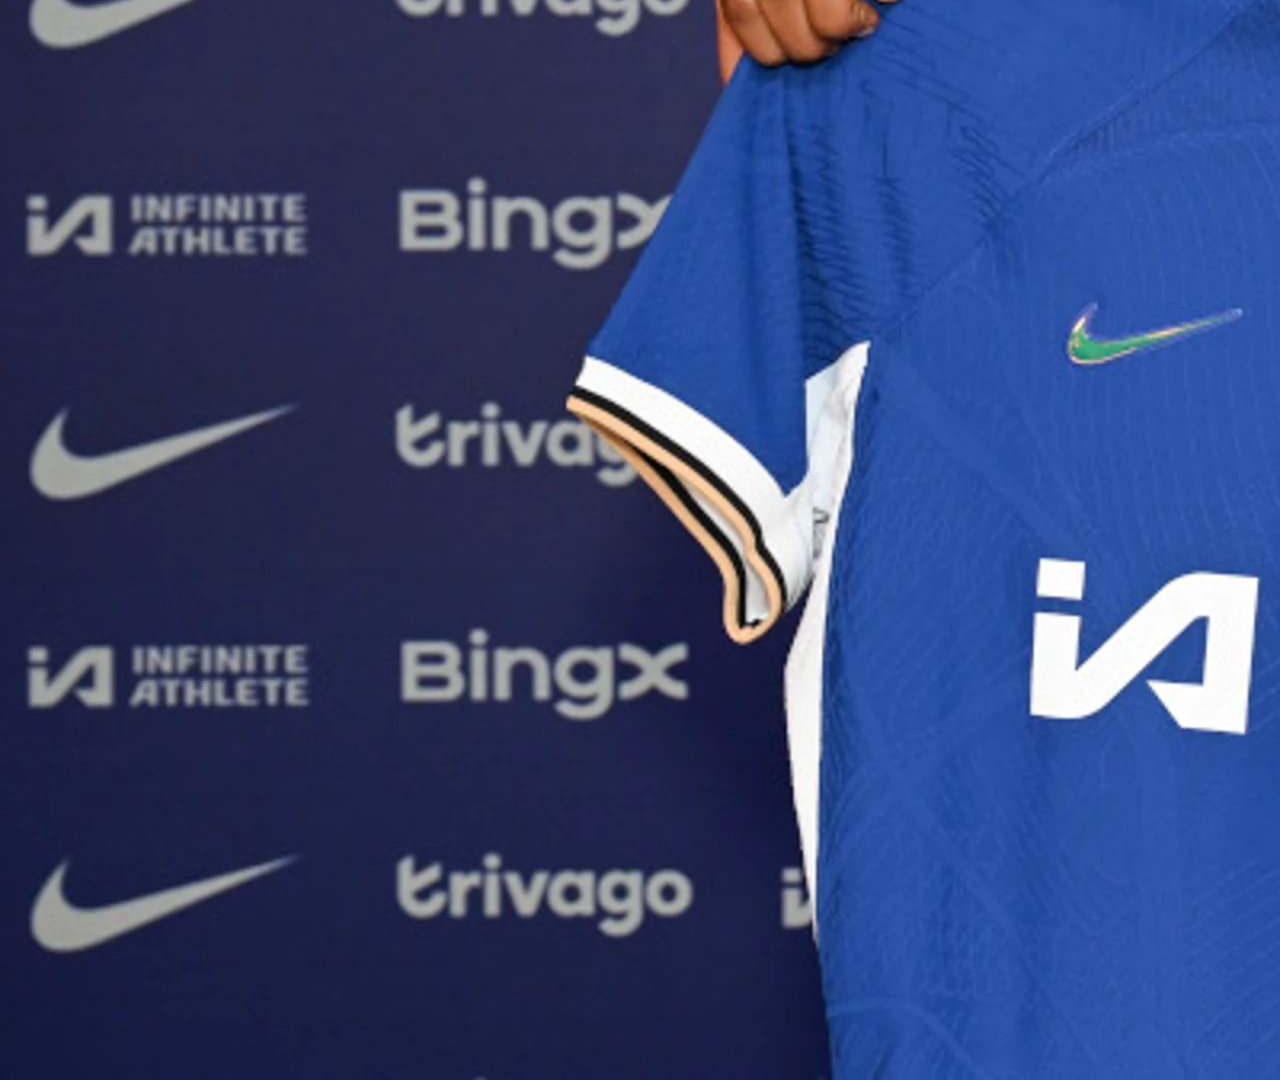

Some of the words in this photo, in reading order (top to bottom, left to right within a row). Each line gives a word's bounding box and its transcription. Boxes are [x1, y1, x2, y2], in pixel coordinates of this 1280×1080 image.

[131, 195, 304, 222] INFINITE
[130, 226, 303, 254] ATHLETE
[133, 645, 305, 673] INFINITE
[130, 678, 307, 706] ATHLETE
[397, 854, 692, 936] trivago
